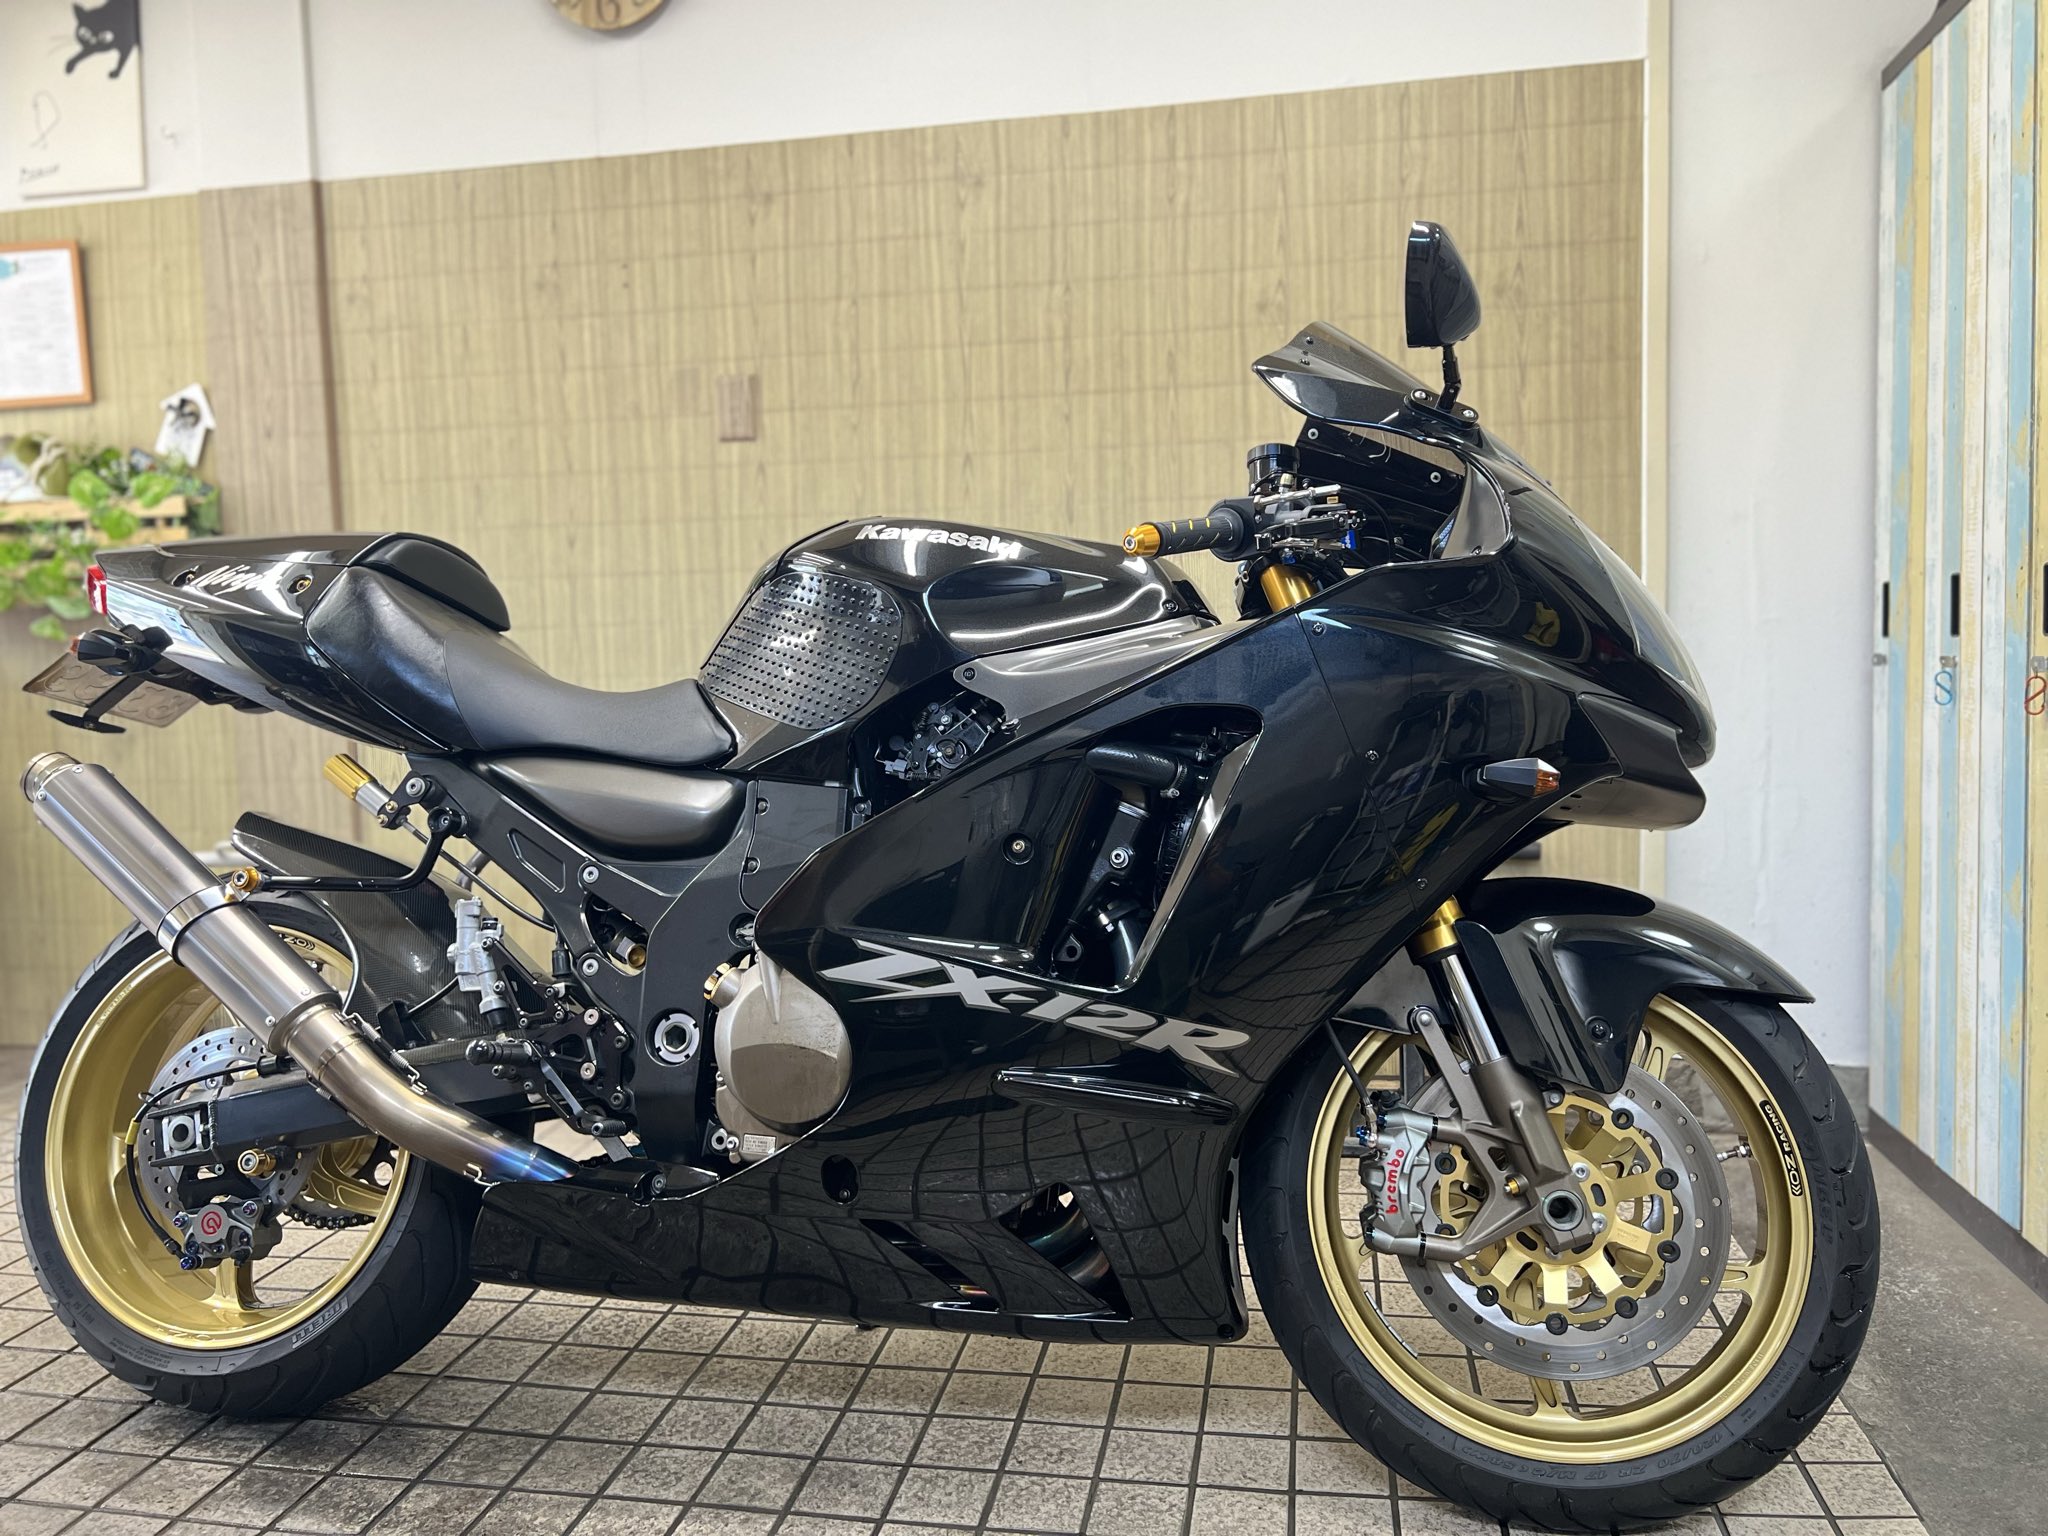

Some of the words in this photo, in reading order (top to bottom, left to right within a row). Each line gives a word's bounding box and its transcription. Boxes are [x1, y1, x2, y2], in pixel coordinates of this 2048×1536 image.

[855, 524, 1023, 560] Kawasaki
[189, 563, 284, 596] Ninja
[817, 938, 1251, 1078] ZX-12R
[1764, 1103, 1792, 1152] RACING
[1385, 1148, 1405, 1214] brembo
[291, 1296, 350, 1349] PIRELLI
